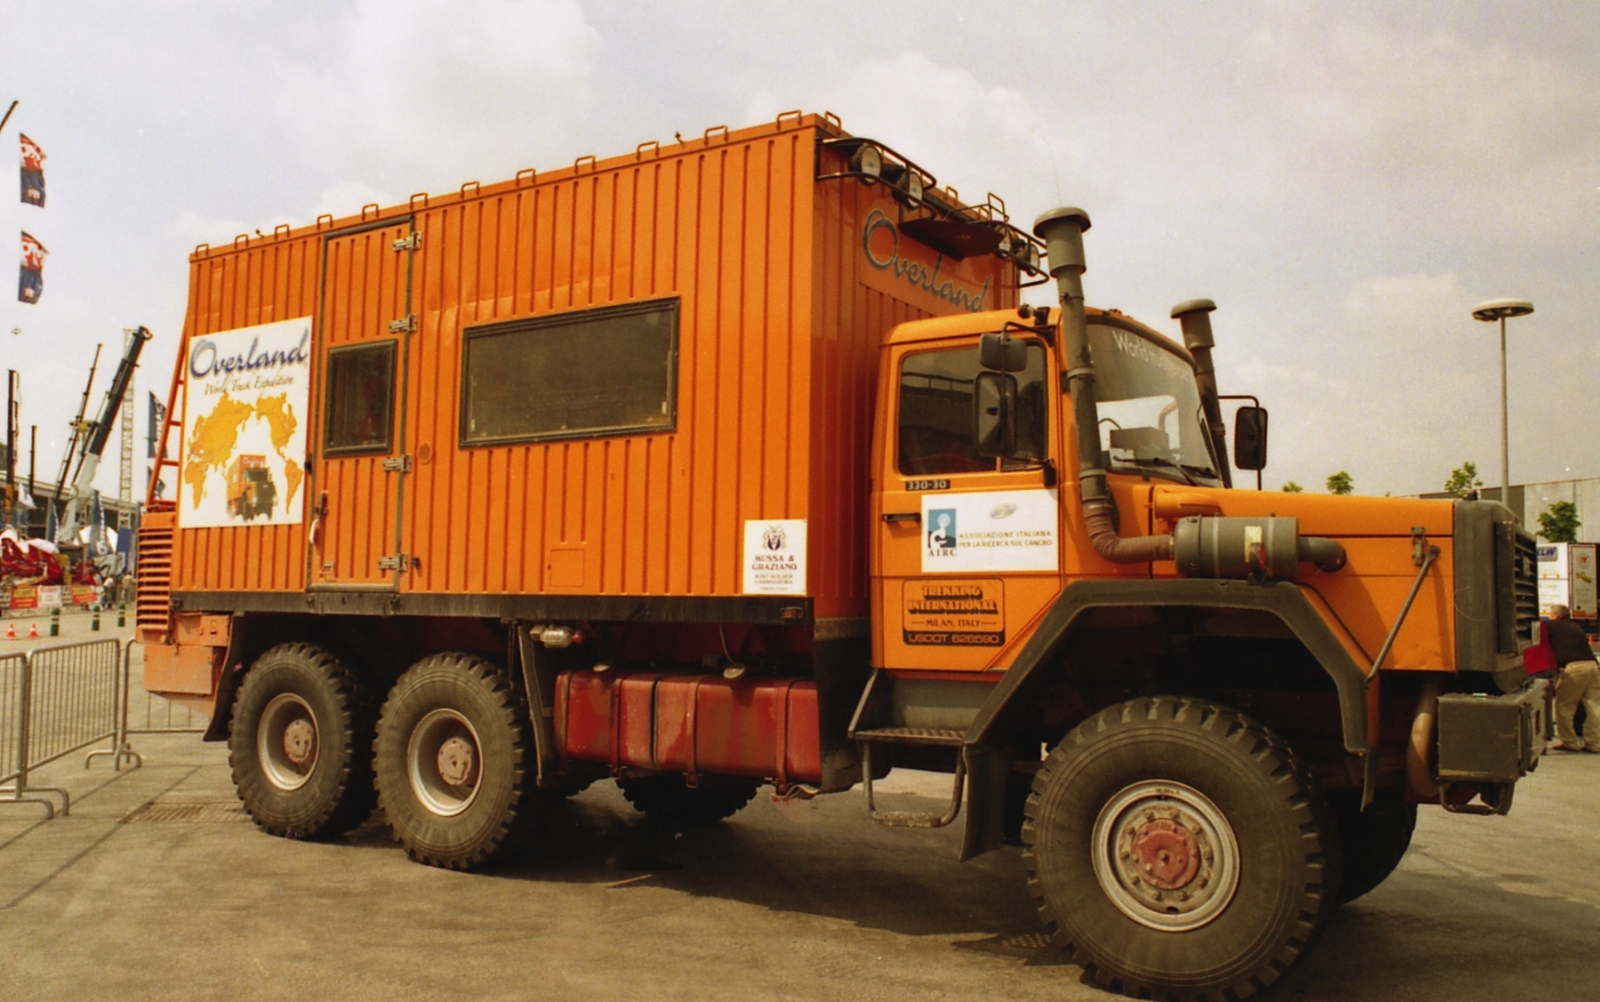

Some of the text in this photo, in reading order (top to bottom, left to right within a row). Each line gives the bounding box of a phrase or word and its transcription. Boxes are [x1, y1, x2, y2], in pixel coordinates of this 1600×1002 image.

[863, 208, 990, 313] Overland
[189, 328, 308, 379] Overland
[908, 480, 947, 490] 330-30
[959, 531, 1013, 539] ASSOCIAZIONE
[928, 549, 957, 557] AIRC
[752, 563, 797, 571] GRAZIANO
[922, 586, 983, 600] TREKKING
[908, 601, 998, 614] INTERNATIONAL
